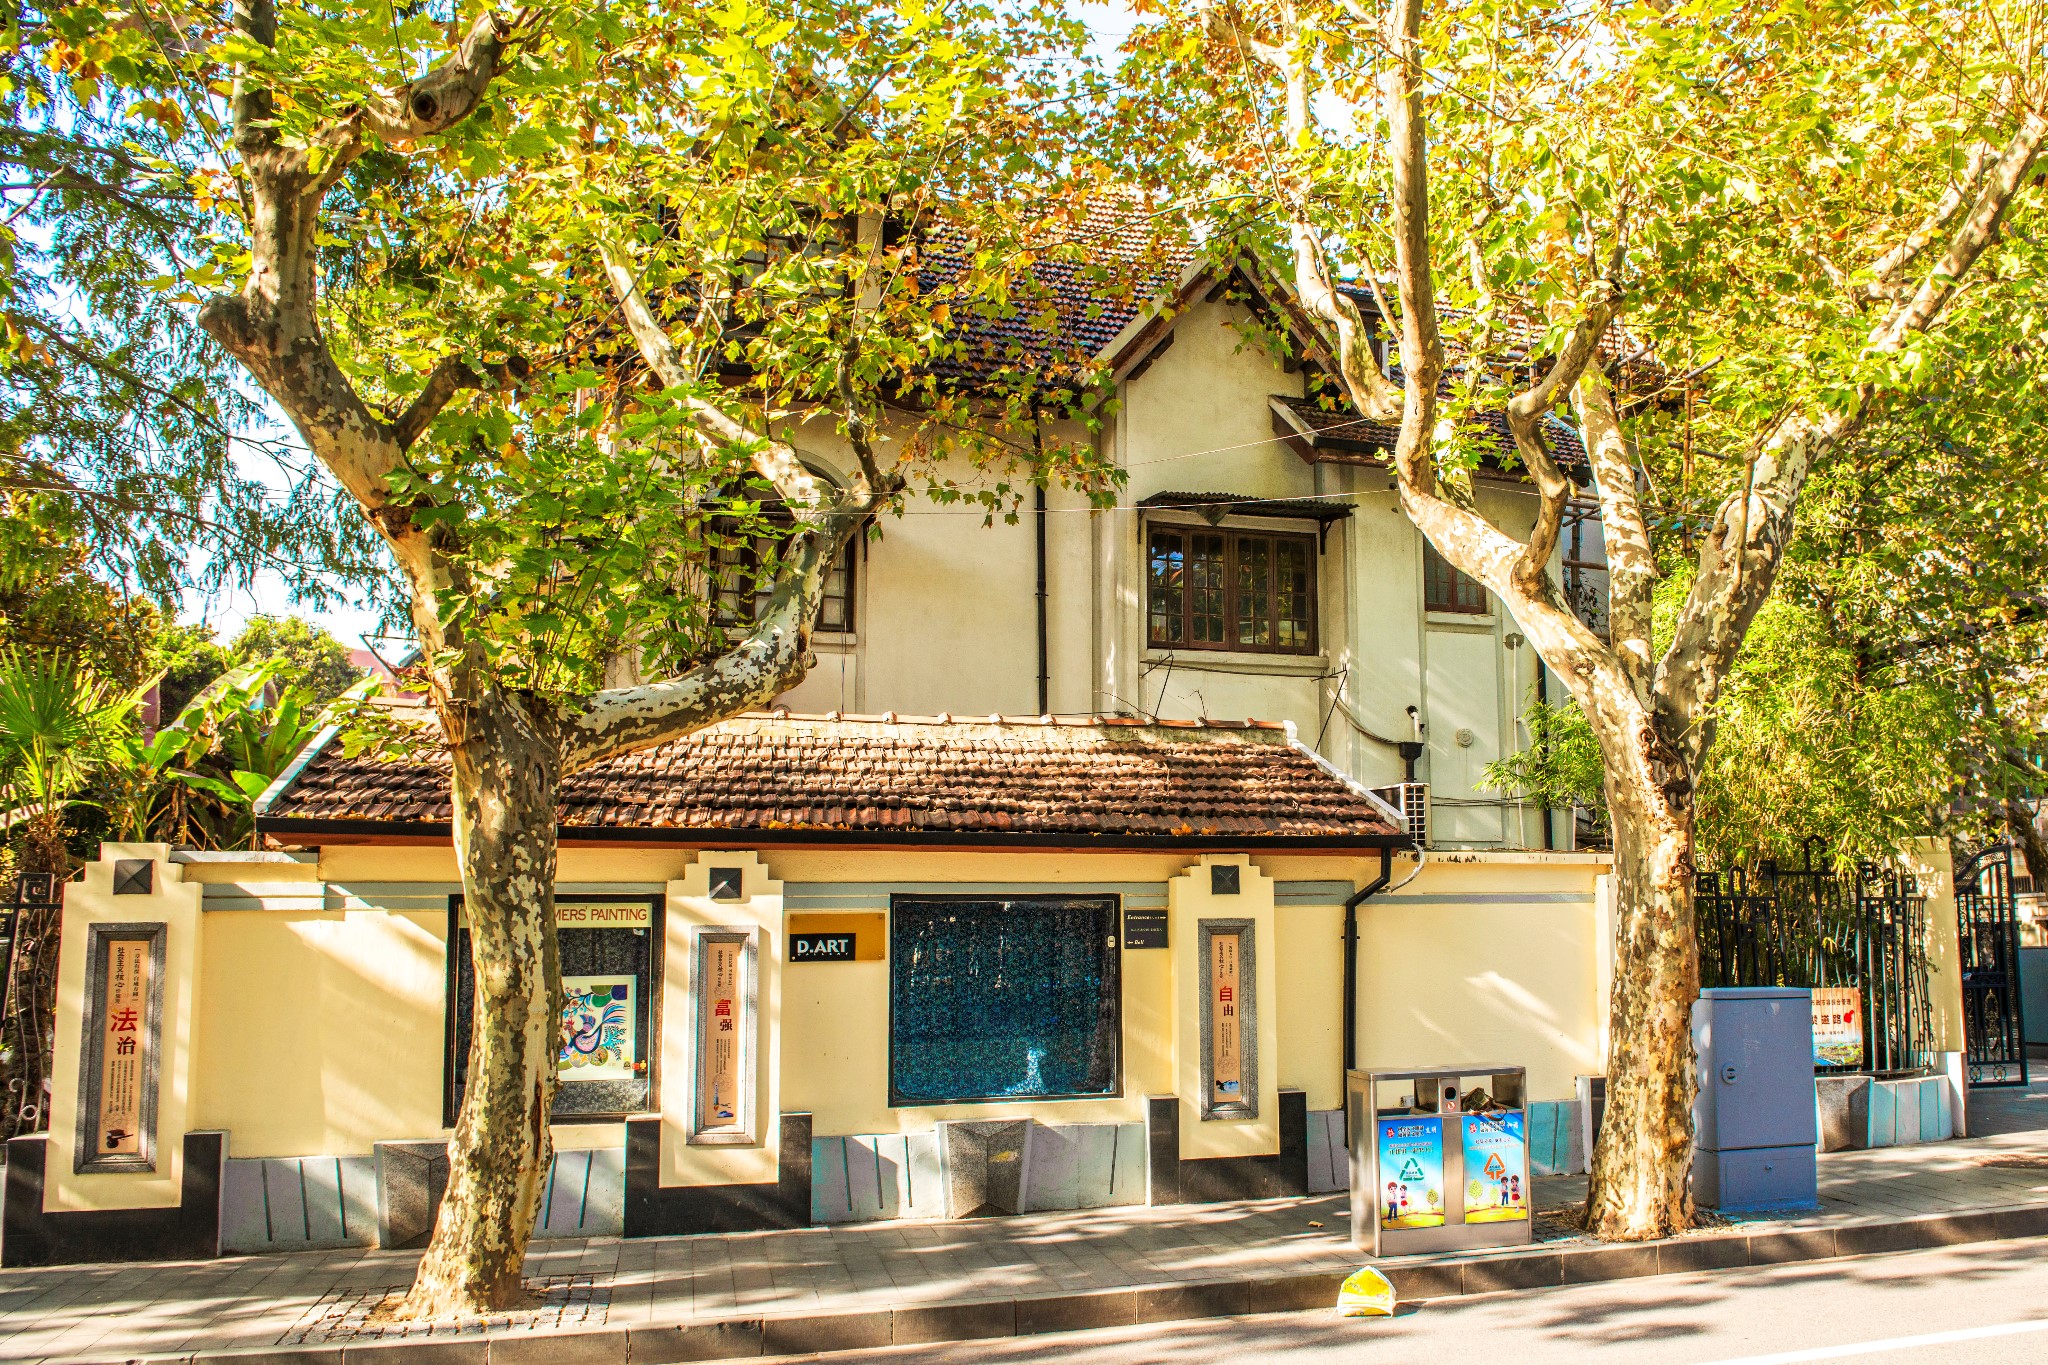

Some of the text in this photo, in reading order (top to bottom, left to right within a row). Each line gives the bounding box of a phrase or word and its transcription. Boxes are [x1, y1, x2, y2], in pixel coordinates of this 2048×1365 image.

[590, 908, 648, 921] PAINTING
[797, 939, 849, 954] D.ART
[714, 999, 733, 1031] 富强
[1220, 986, 1233, 1016] 自由
[110, 1007, 138, 1056] 法治
